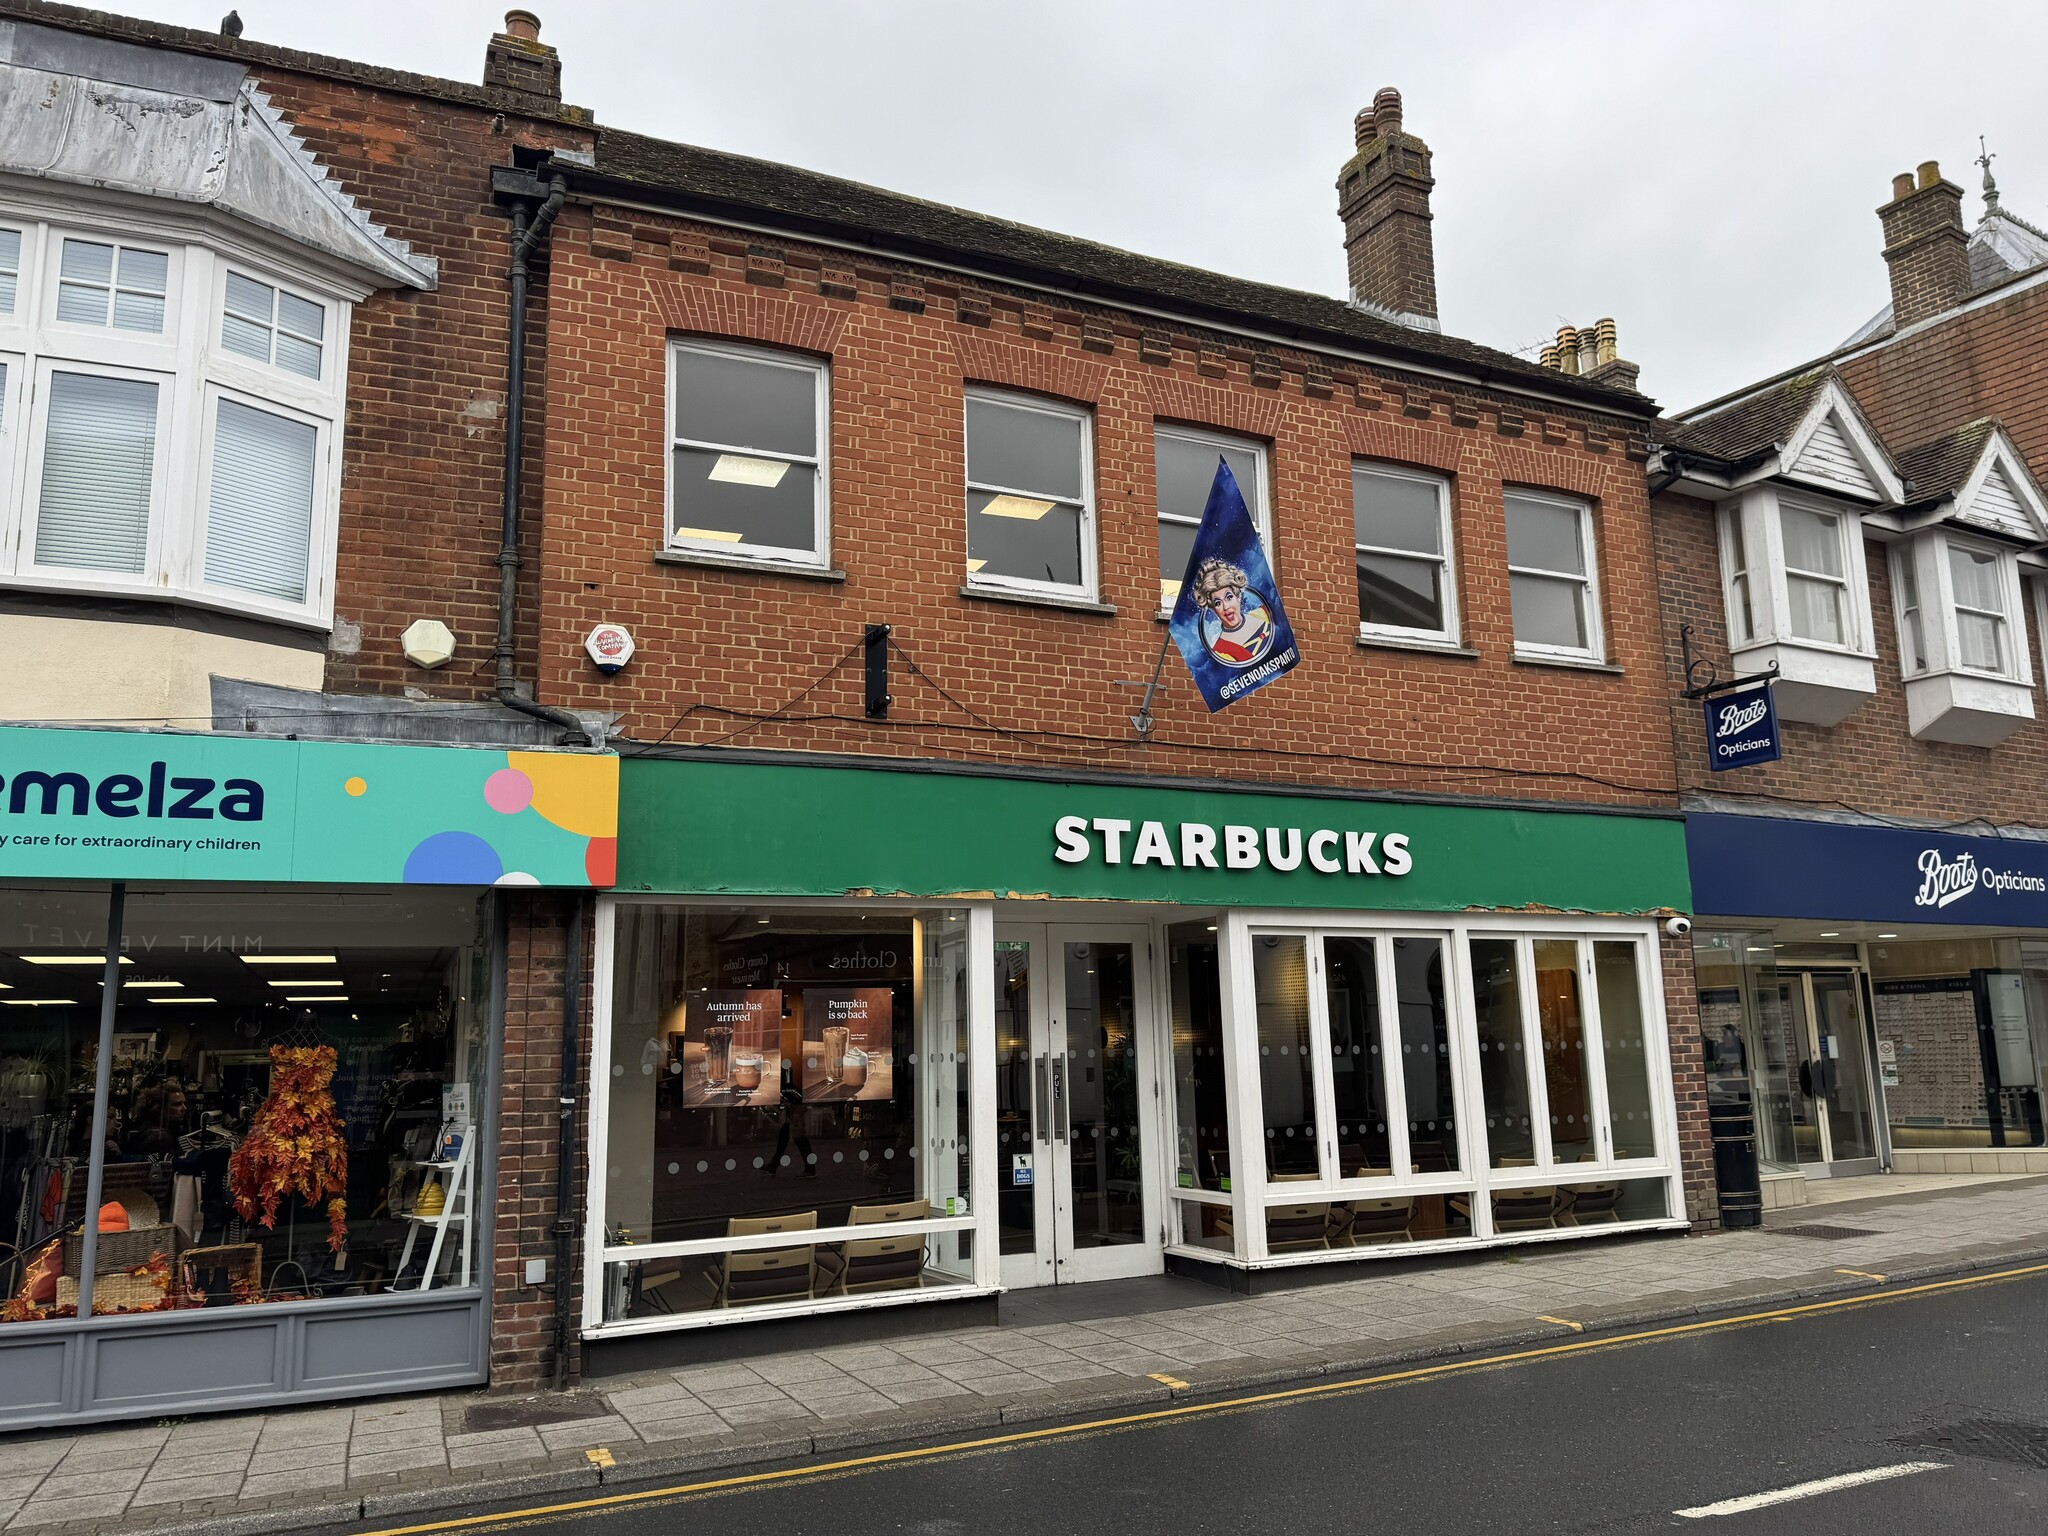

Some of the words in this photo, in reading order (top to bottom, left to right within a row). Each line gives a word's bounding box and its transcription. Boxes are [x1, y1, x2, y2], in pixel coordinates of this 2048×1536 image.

[1220, 647, 1296, 699] @SEVENOAKSPANTO
[1716, 698, 1767, 737] Boots
[1718, 738, 1771, 757] Opticians
[0, 760, 264, 821] melza
[12, 835, 50, 845] care
[54, 833, 77, 846] for
[82, 836, 192, 852] extraordinary
[195, 838, 261, 850] children
[1054, 815, 1413, 876] STARBUCKS
[1915, 849, 1978, 909] Boots
[1982, 867, 2046, 895] Opticians
[706, 1002, 744, 1011] Autumn
[745, 1001, 762, 1010] has
[828, 999, 868, 1010] Pumpkin
[717, 1012, 751, 1022] arrived
[828, 1010, 836, 1020] is
[836, 1011, 847, 1019] so
[847, 1010, 868, 1019] back
